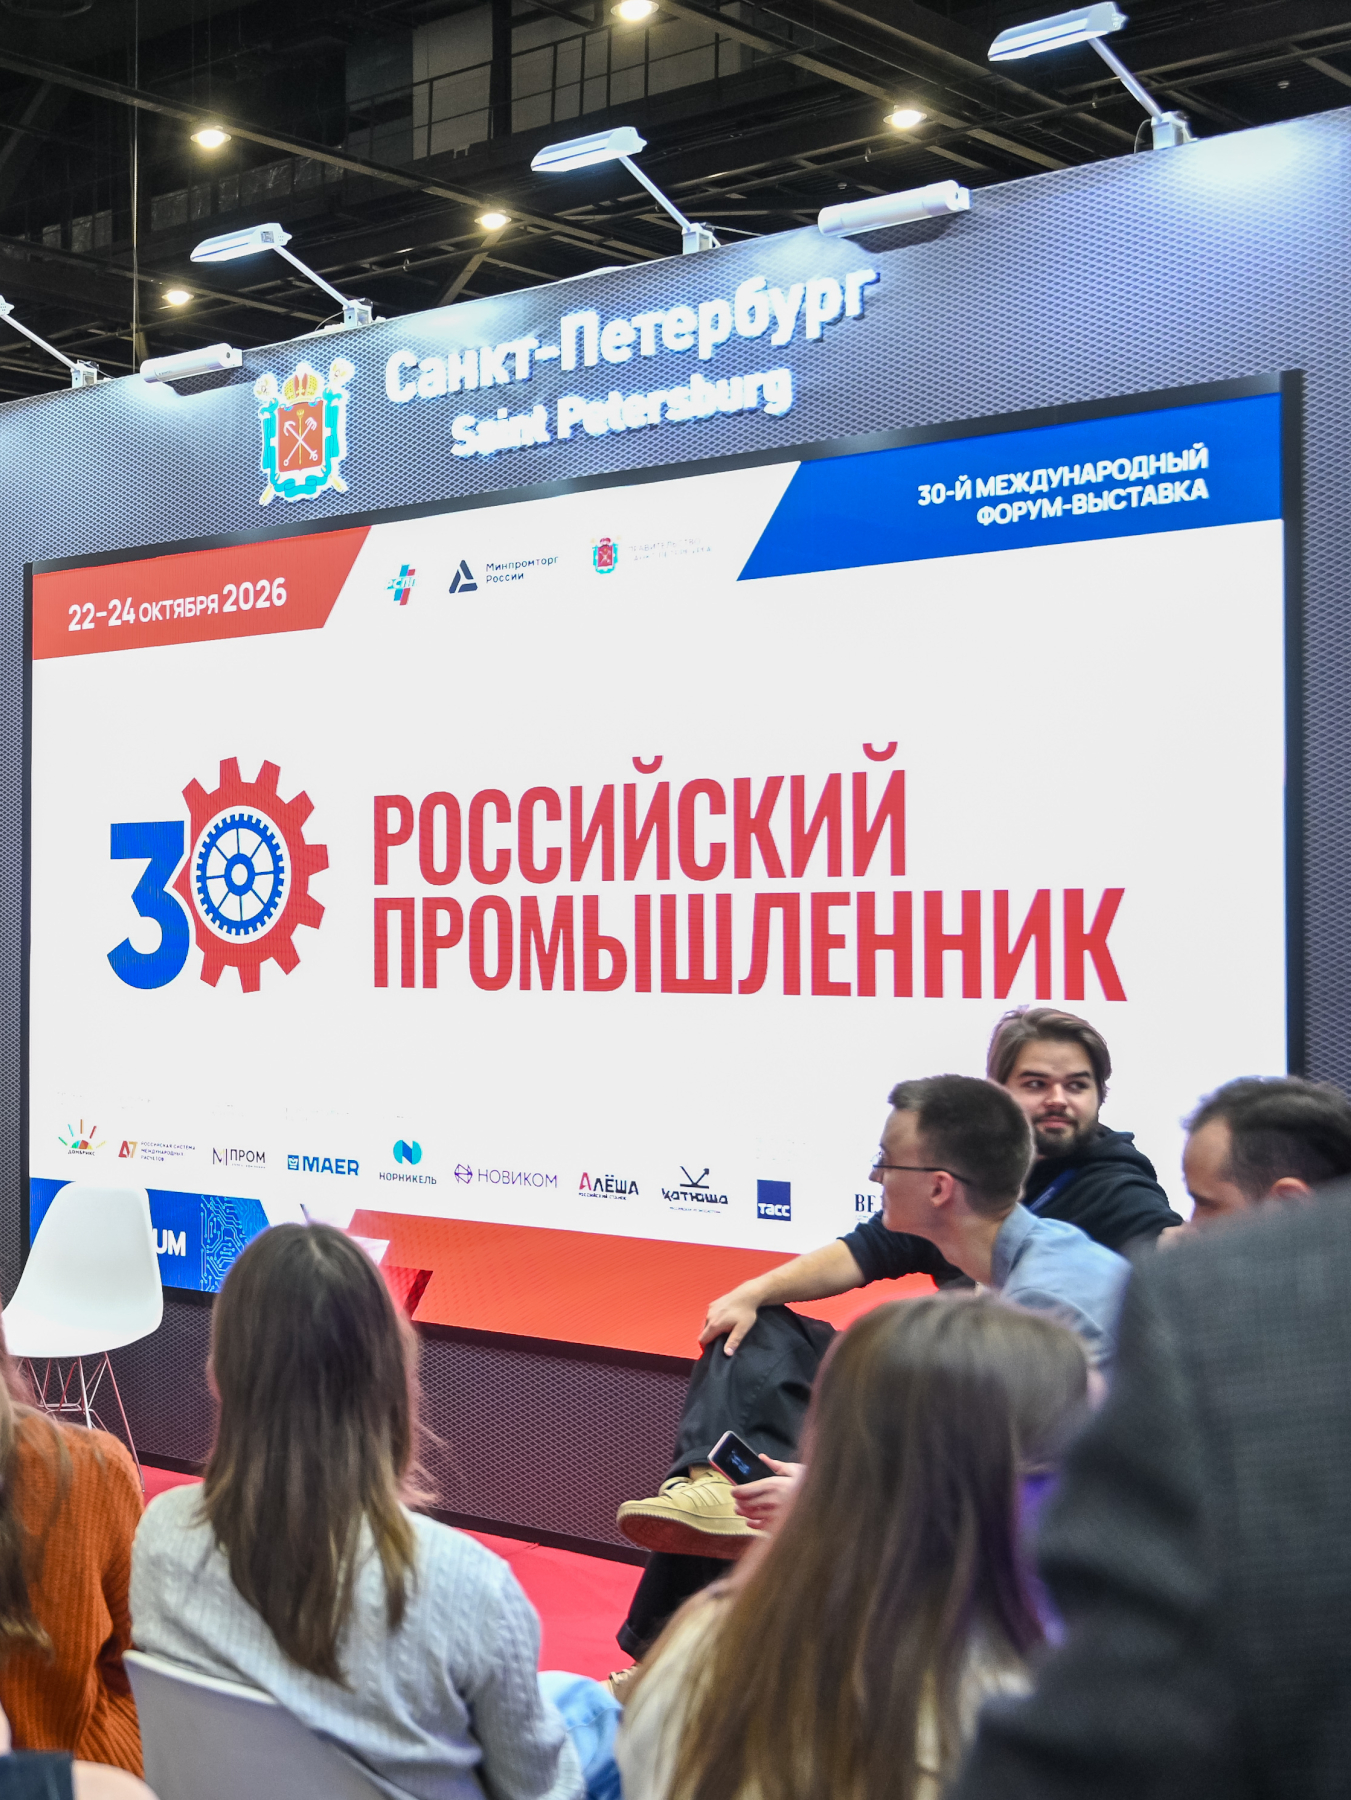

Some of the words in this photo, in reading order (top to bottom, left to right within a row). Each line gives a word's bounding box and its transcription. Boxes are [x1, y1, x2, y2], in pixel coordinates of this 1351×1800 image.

[384, 268, 880, 404] Санкт-Петербург
[451, 407, 550, 457] Saint
[557, 367, 794, 440] Petersburg
[917, 472, 971, 506] 30-Й
[976, 442, 1209, 499] МЕЖДУНАРОДНЫЙ
[977, 478, 1209, 526] ФОРУМ-ВЫСТАВКА
[486, 556, 559, 572] Минпромторг
[486, 573, 524, 584] России
[139, 594, 219, 622] ОКТЯБРЯ
[222, 577, 287, 613] 2026
[374, 741, 906, 885] РОССИЙСКИЙ
[374, 887, 1126, 1001] ПРОМЫШЛЕННИК
[302, 1155, 360, 1176] MAER
[379, 1172, 437, 1185] НОРНИКЕЛЬ
[478, 1169, 558, 1188] НОВИКОМ
